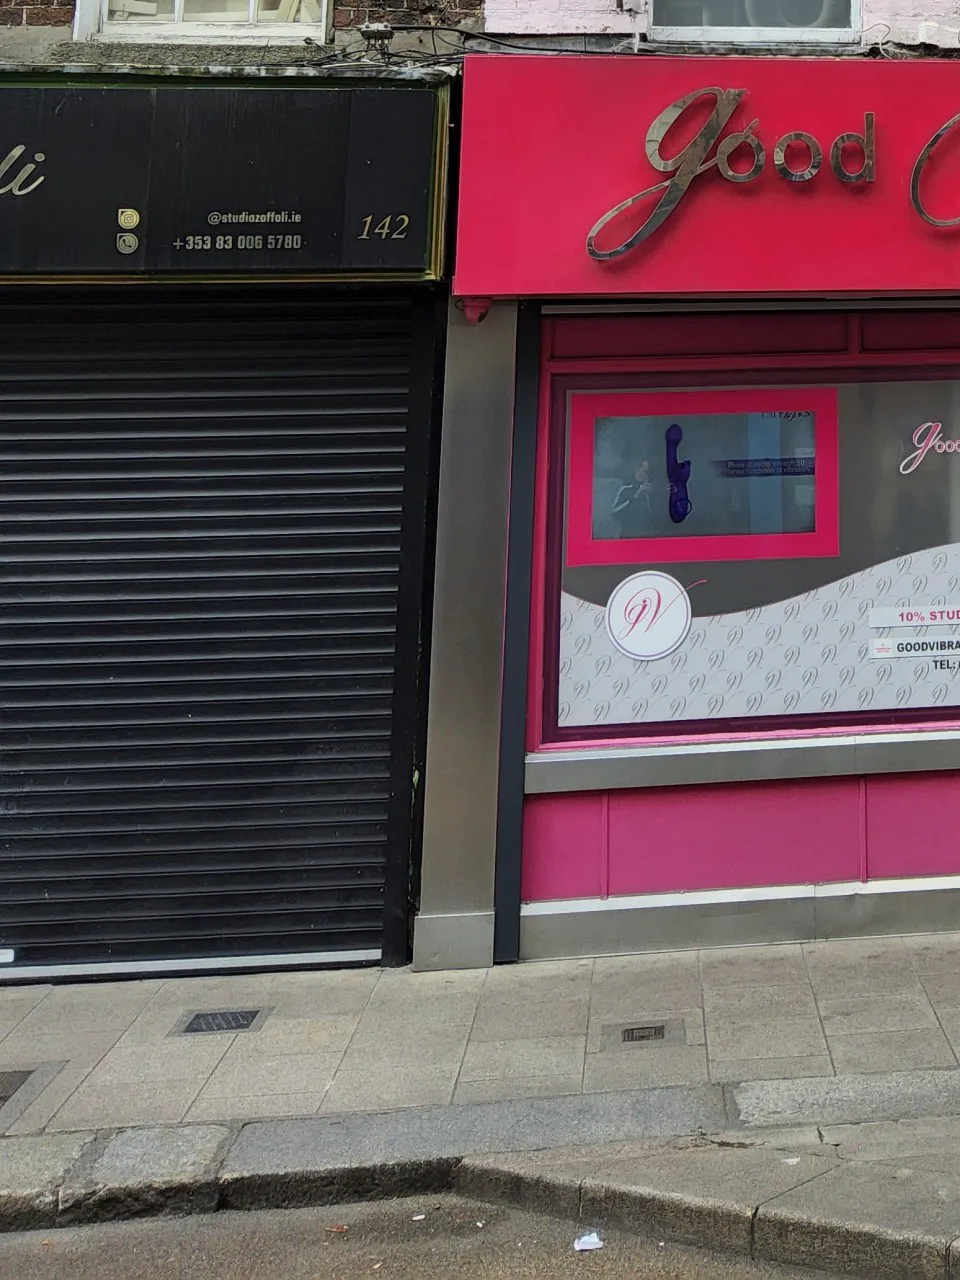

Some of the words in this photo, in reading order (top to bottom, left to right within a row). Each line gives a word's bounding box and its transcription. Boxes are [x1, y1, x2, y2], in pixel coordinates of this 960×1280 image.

[207, 211, 302, 225] @studiozoffoli.ie
[357, 214, 410, 240] 142
[173, 235, 211, 249] +353
[216, 235, 233, 249] 83
[237, 235, 262, 249] 006
[267, 235, 301, 249] 5780
[899, 611, 925, 622] 10%
[933, 659, 956, 670] TEL:
